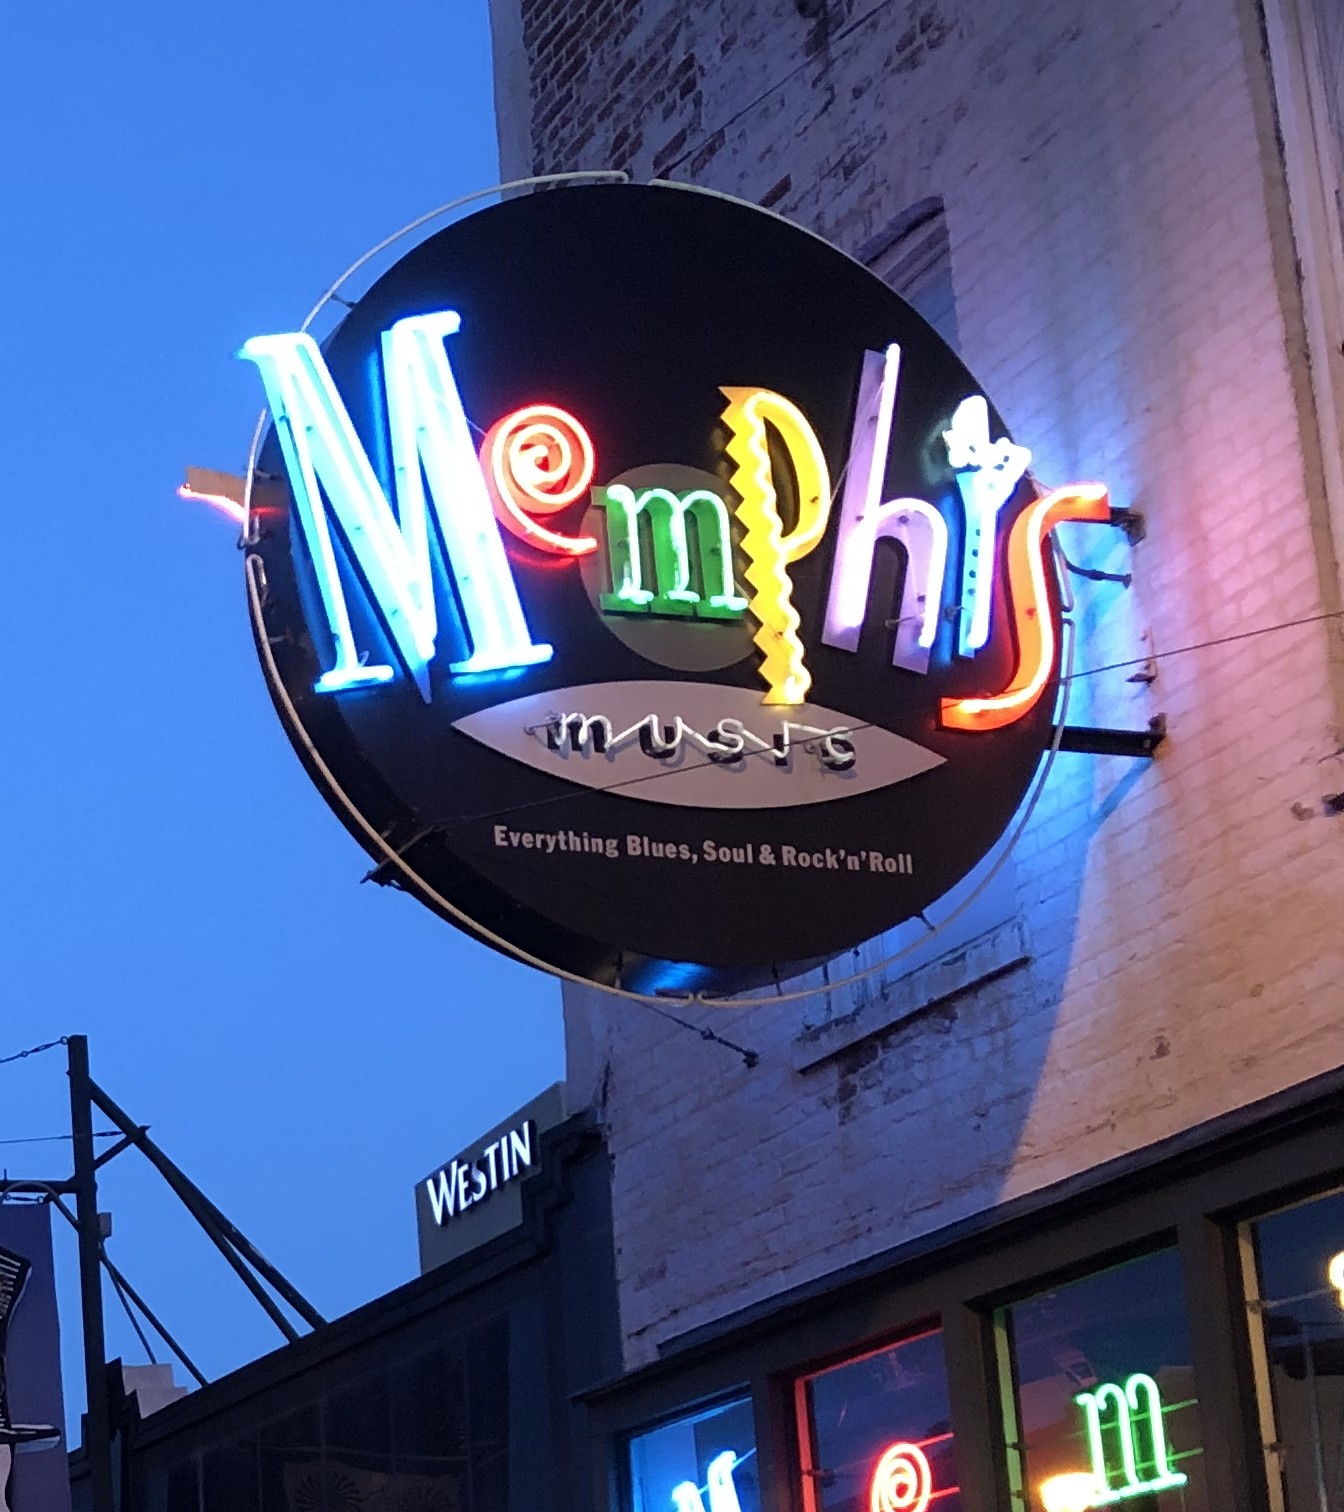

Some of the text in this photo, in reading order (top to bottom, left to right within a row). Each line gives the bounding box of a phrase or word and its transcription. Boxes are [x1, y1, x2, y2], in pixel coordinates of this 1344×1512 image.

[237, 305, 1112, 734] Memphis
[527, 708, 860, 774] music
[493, 825, 913, 874] Everything Blues, Soul & Rock'n'Roll
[426, 1119, 532, 1226] WESTIN
